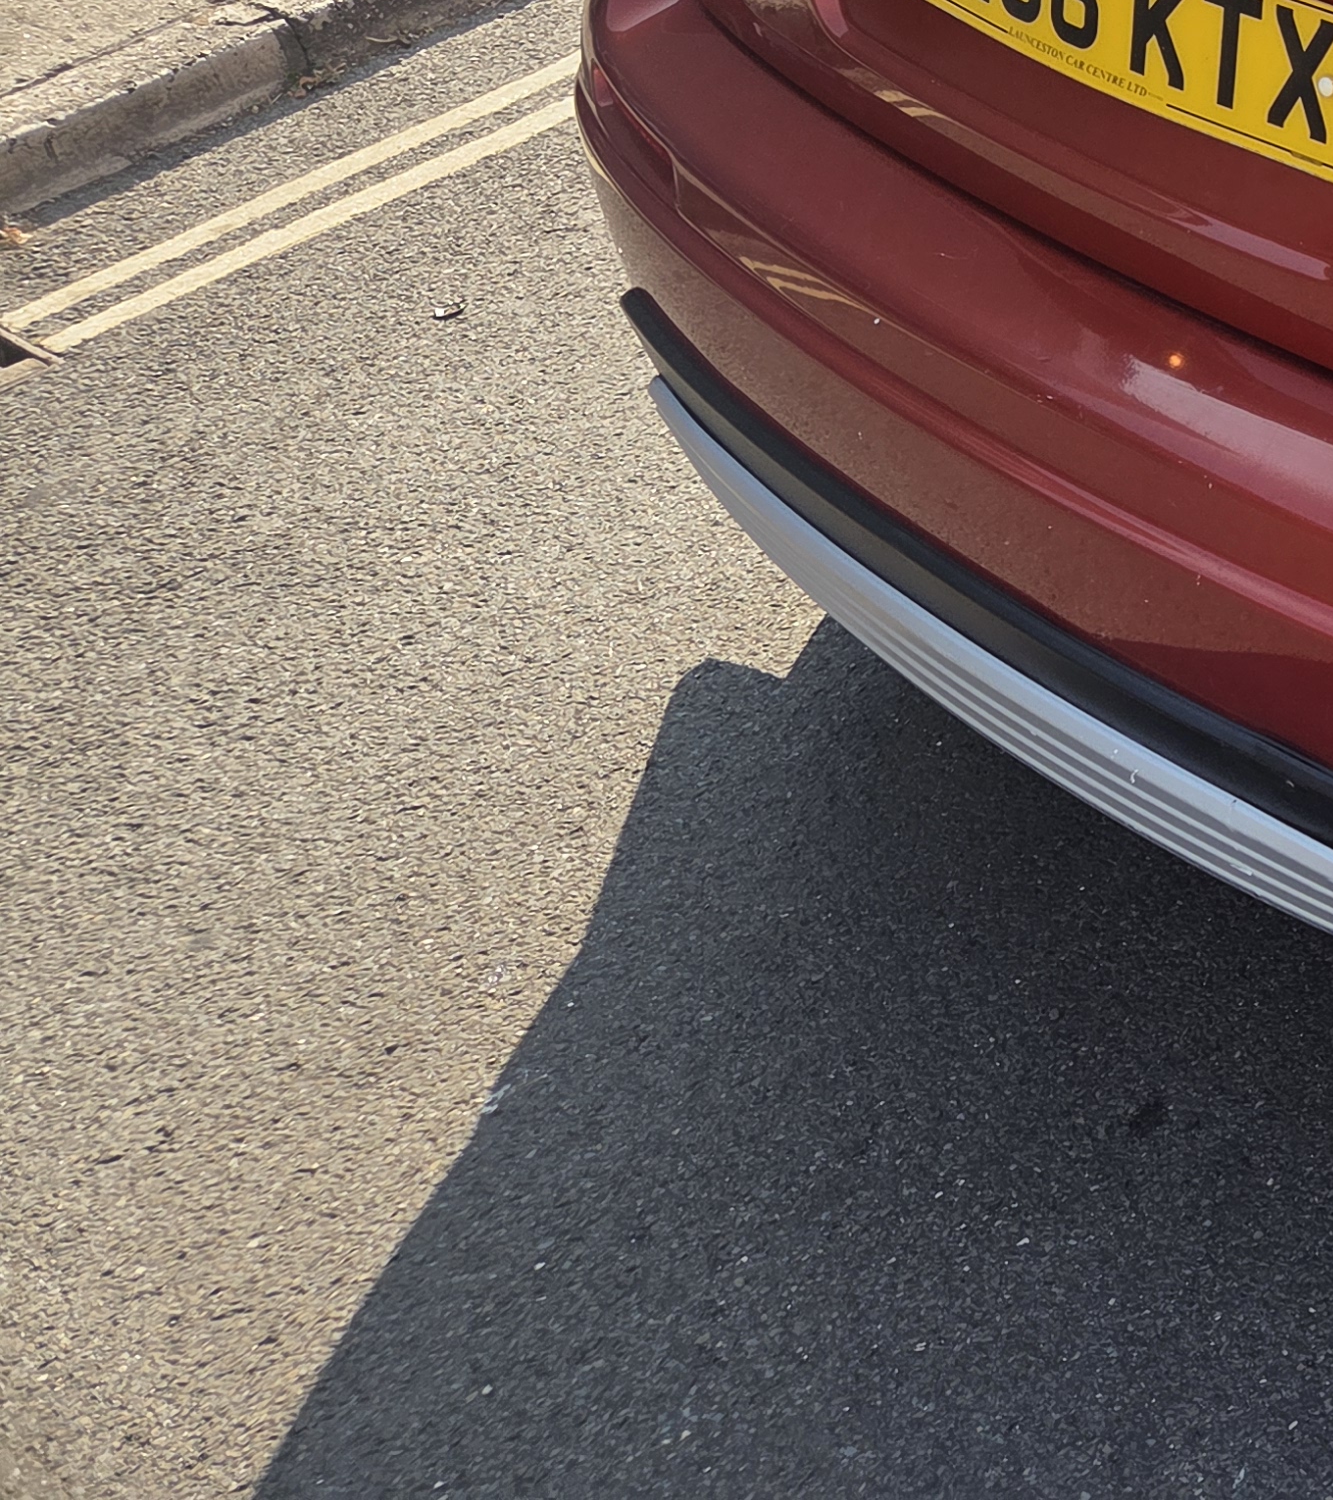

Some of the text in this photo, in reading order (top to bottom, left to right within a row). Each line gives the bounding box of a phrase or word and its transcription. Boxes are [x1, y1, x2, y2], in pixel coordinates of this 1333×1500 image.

[1008, 26, 1065, 62] LAUNCESTON
[1065, 54, 1084, 71] CAR
[1086, 63, 1126, 90] CENTRE
[1126, 79, 1148, 98] LTD
